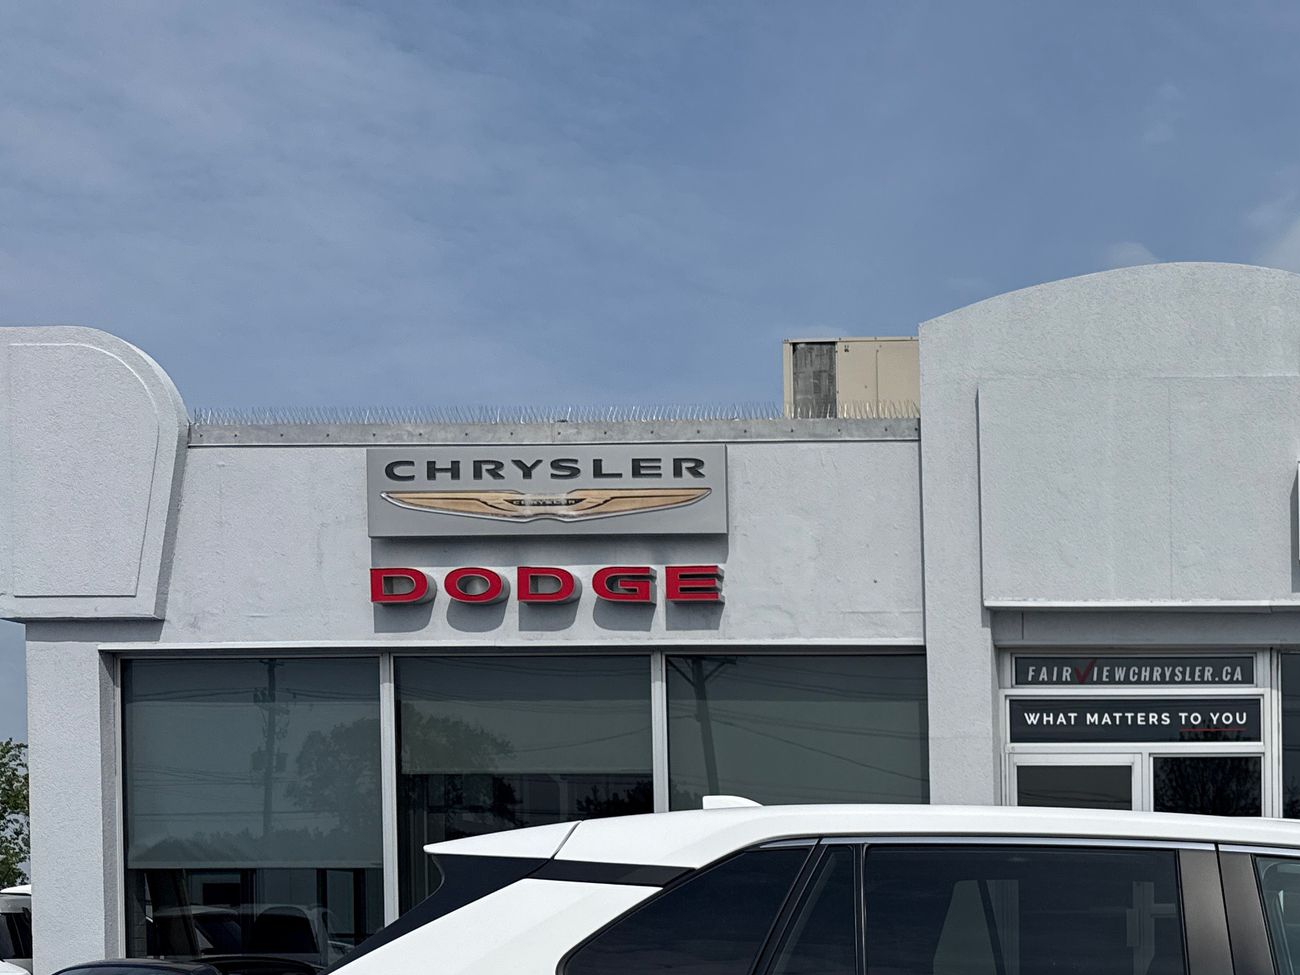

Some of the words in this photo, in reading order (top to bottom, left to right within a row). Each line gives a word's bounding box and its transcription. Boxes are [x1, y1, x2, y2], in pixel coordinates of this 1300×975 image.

[384, 457, 707, 482] CHRYSLER
[370, 565, 725, 605] DODGE
[1024, 712, 1078, 726] WHAT
[1086, 712, 1171, 726] MATTERS
[1179, 712, 1201, 725] TO
[1210, 712, 1248, 725] YOU
